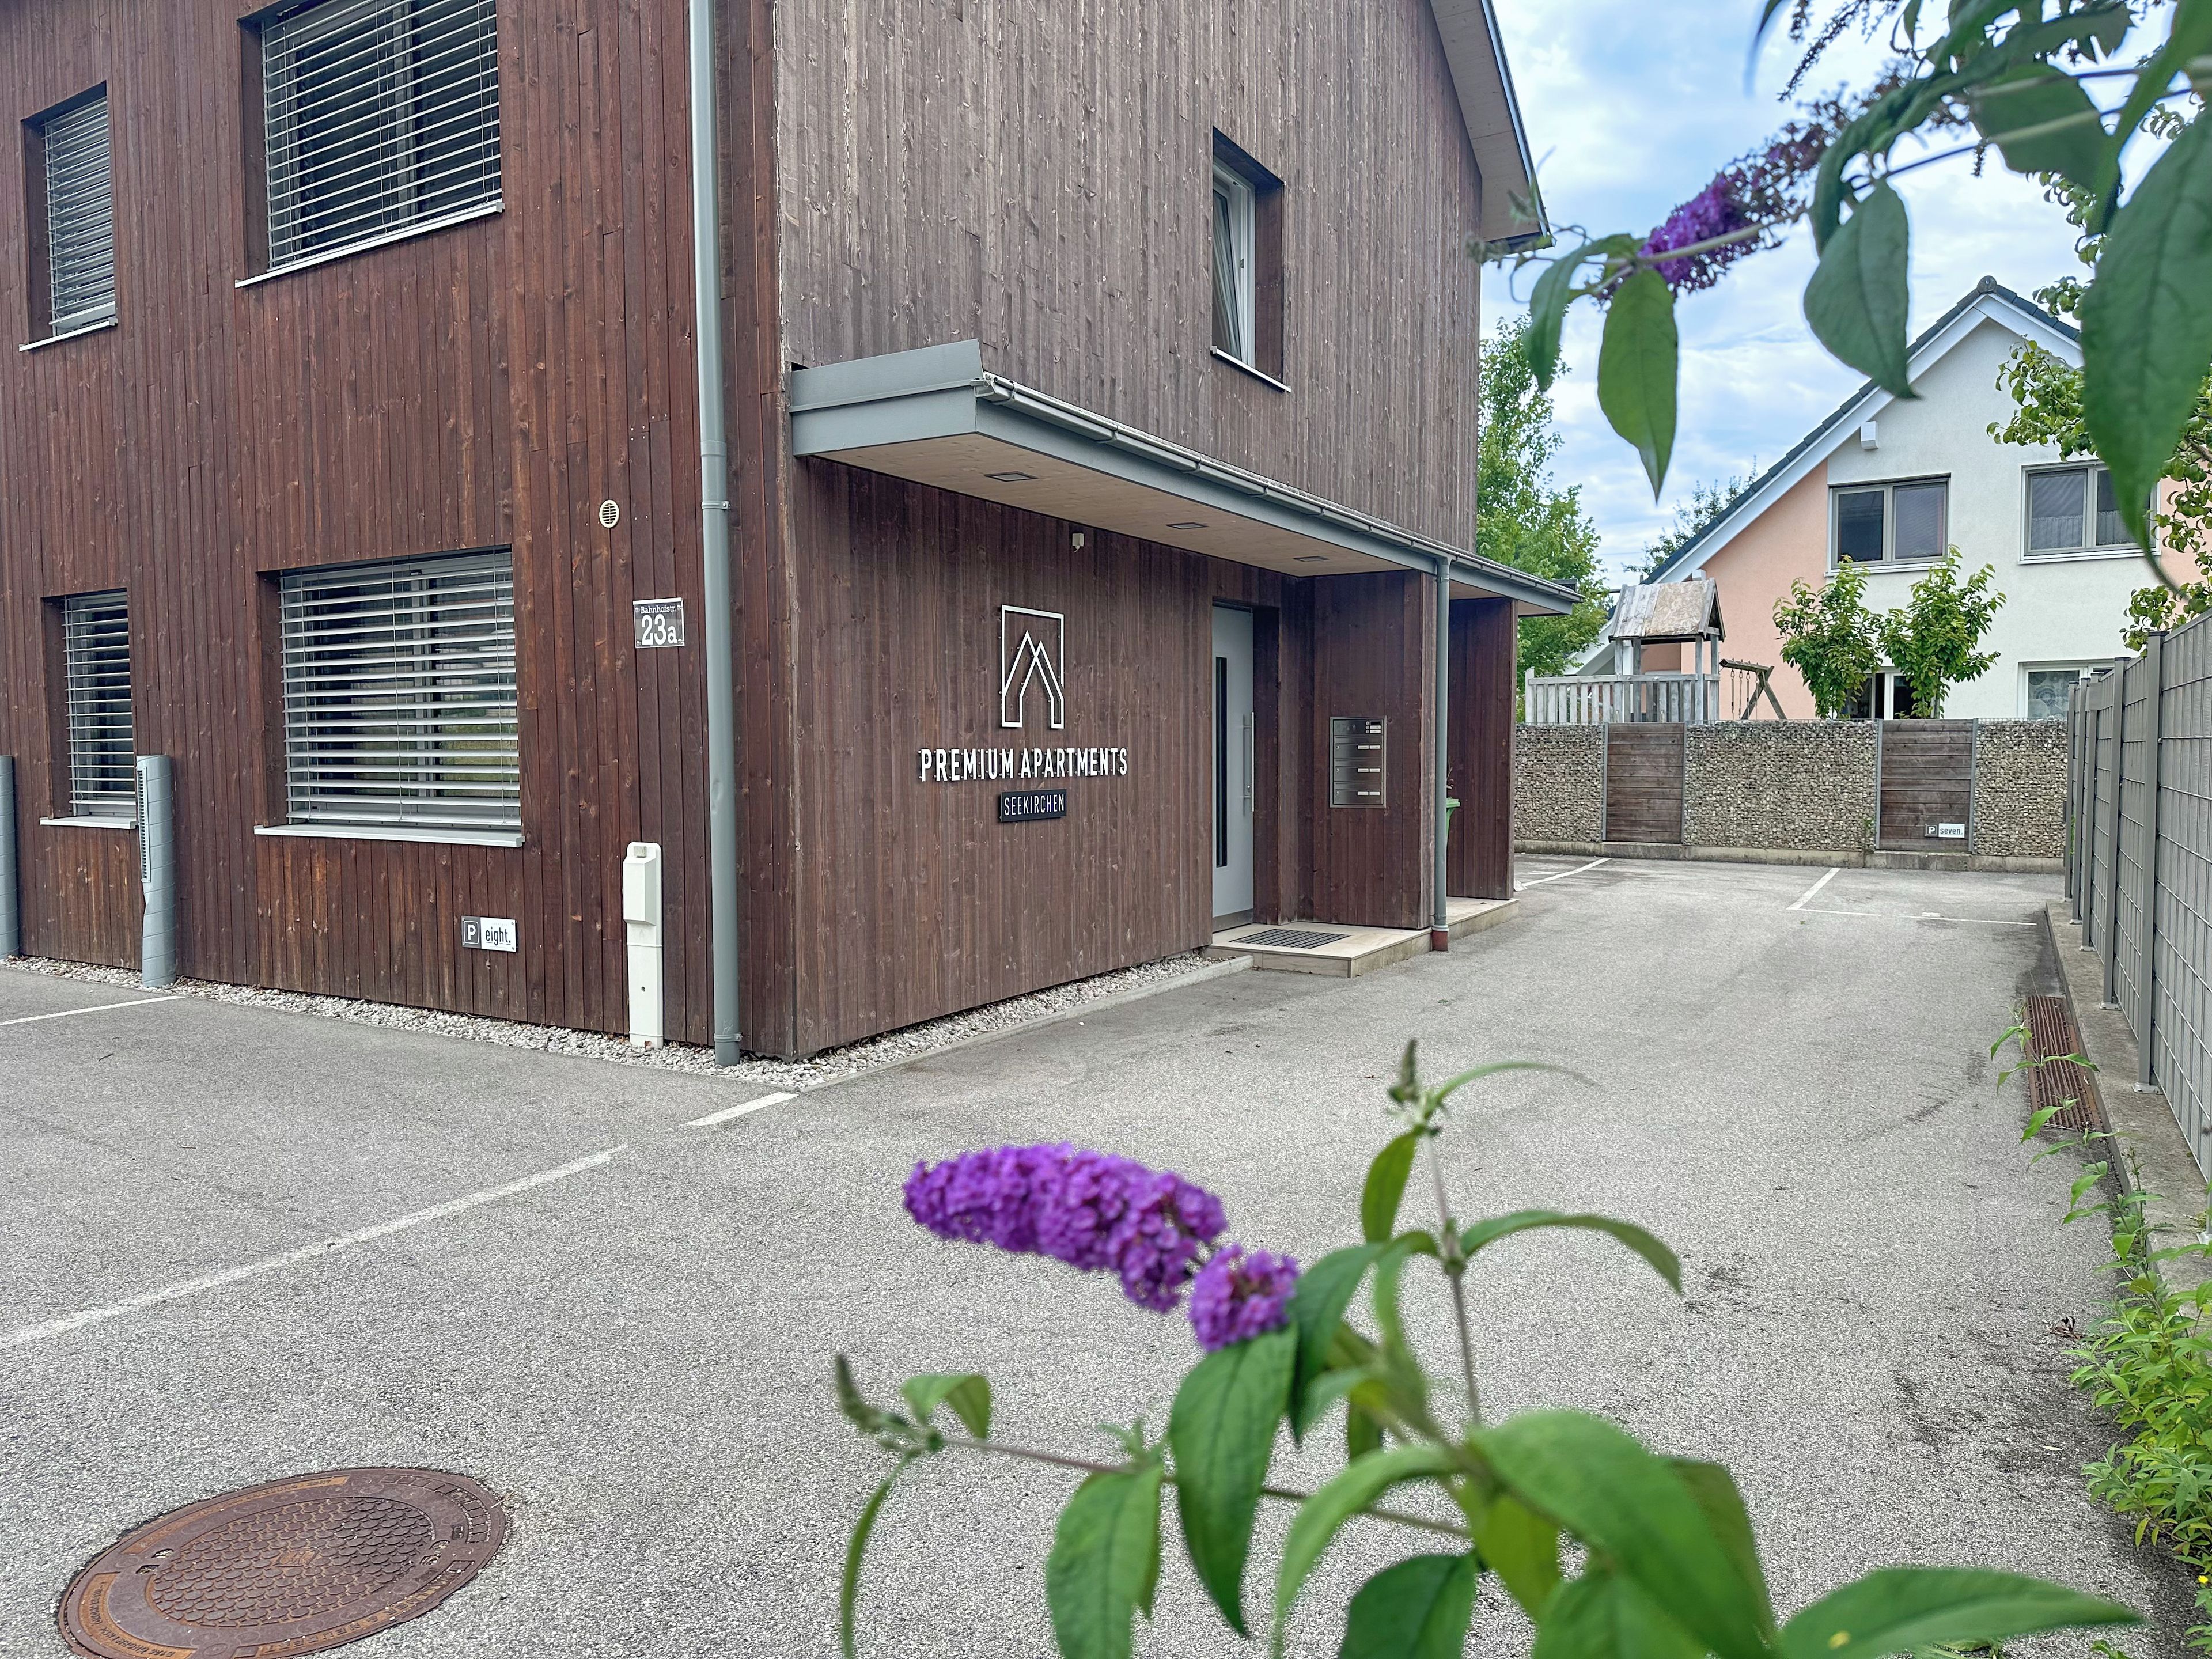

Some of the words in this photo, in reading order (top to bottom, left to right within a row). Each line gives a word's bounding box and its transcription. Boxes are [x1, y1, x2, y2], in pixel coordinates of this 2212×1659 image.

[641, 605, 677, 614] Bahnhofstr.
[641, 613, 678, 646] 23a
[921, 748, 1014, 782] PREMIUM
[1021, 748, 1128, 778] APARTMENTS
[1004, 794, 1065, 816] SEEKIRCHEN
[1929, 826, 1936, 834] P
[467, 924, 476, 941] P
[486, 926, 512, 946] eight.
